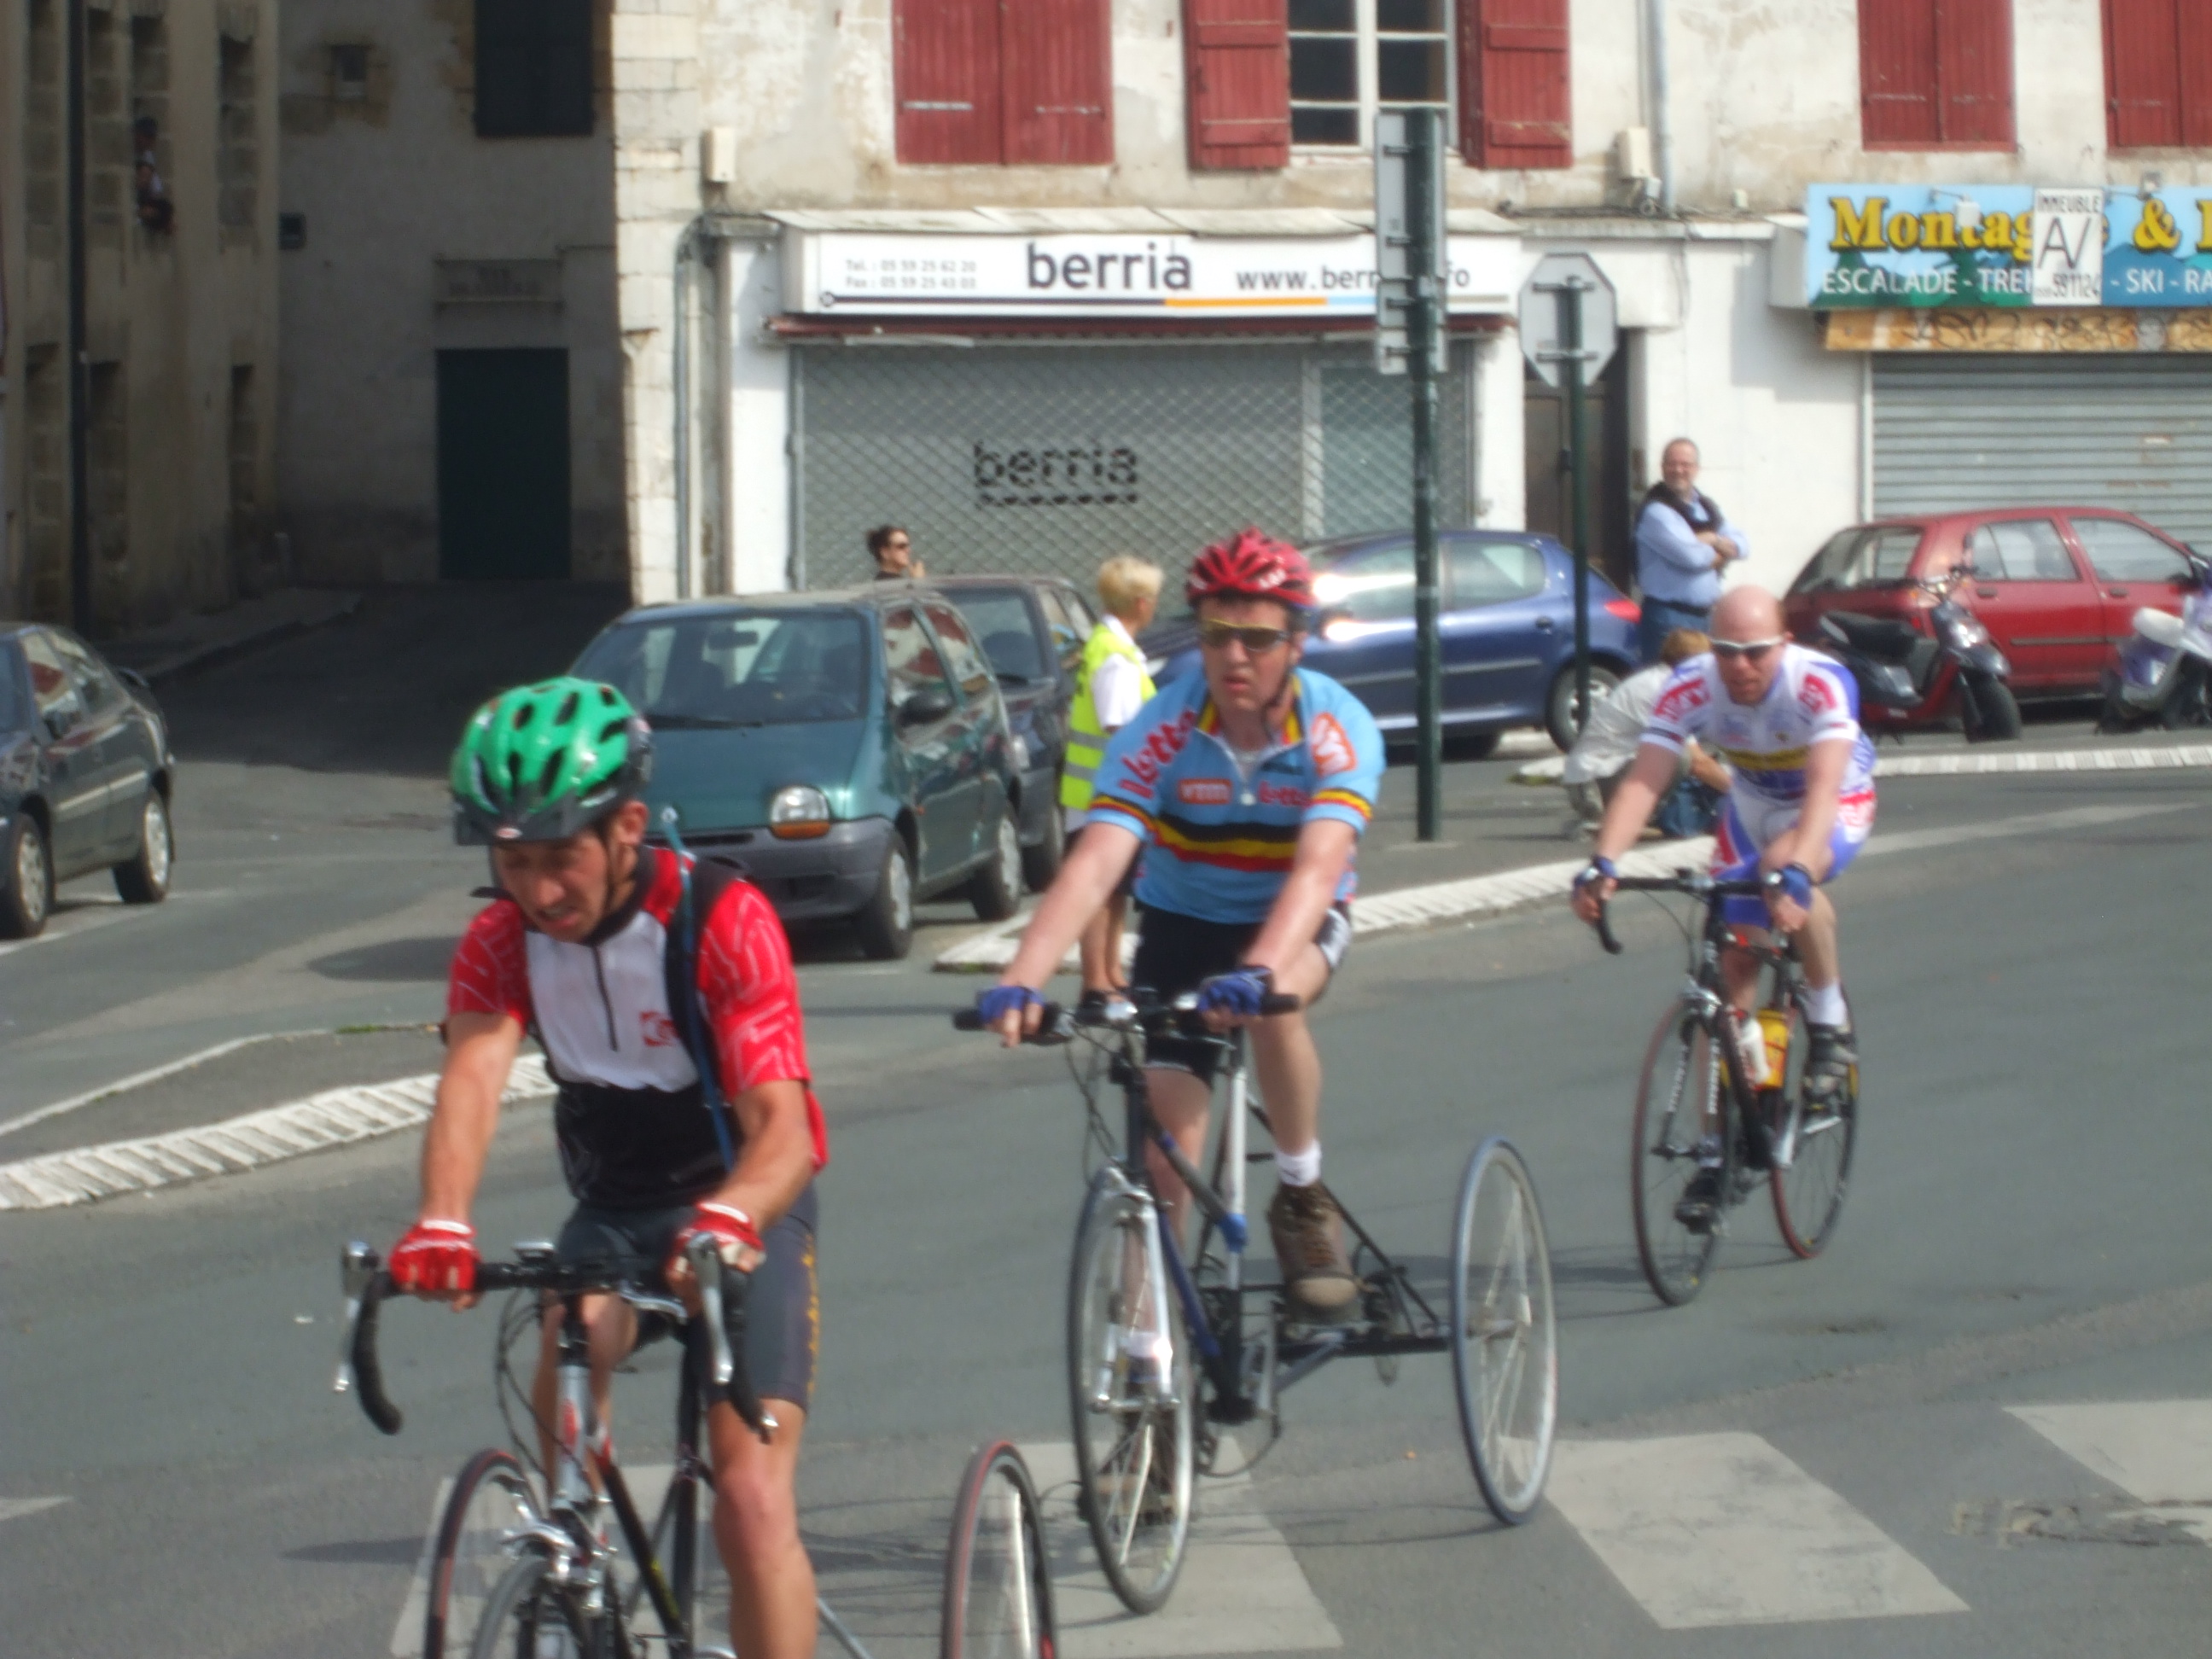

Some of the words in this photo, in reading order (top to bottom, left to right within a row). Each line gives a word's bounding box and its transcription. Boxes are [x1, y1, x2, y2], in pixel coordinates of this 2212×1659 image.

[2134, 198, 2181, 249] &
[1027, 241, 1190, 289] berria
[1822, 268, 1958, 294] ESCALADE
[2127, 268, 2163, 294] SKI
[973, 439, 1138, 487] berria
